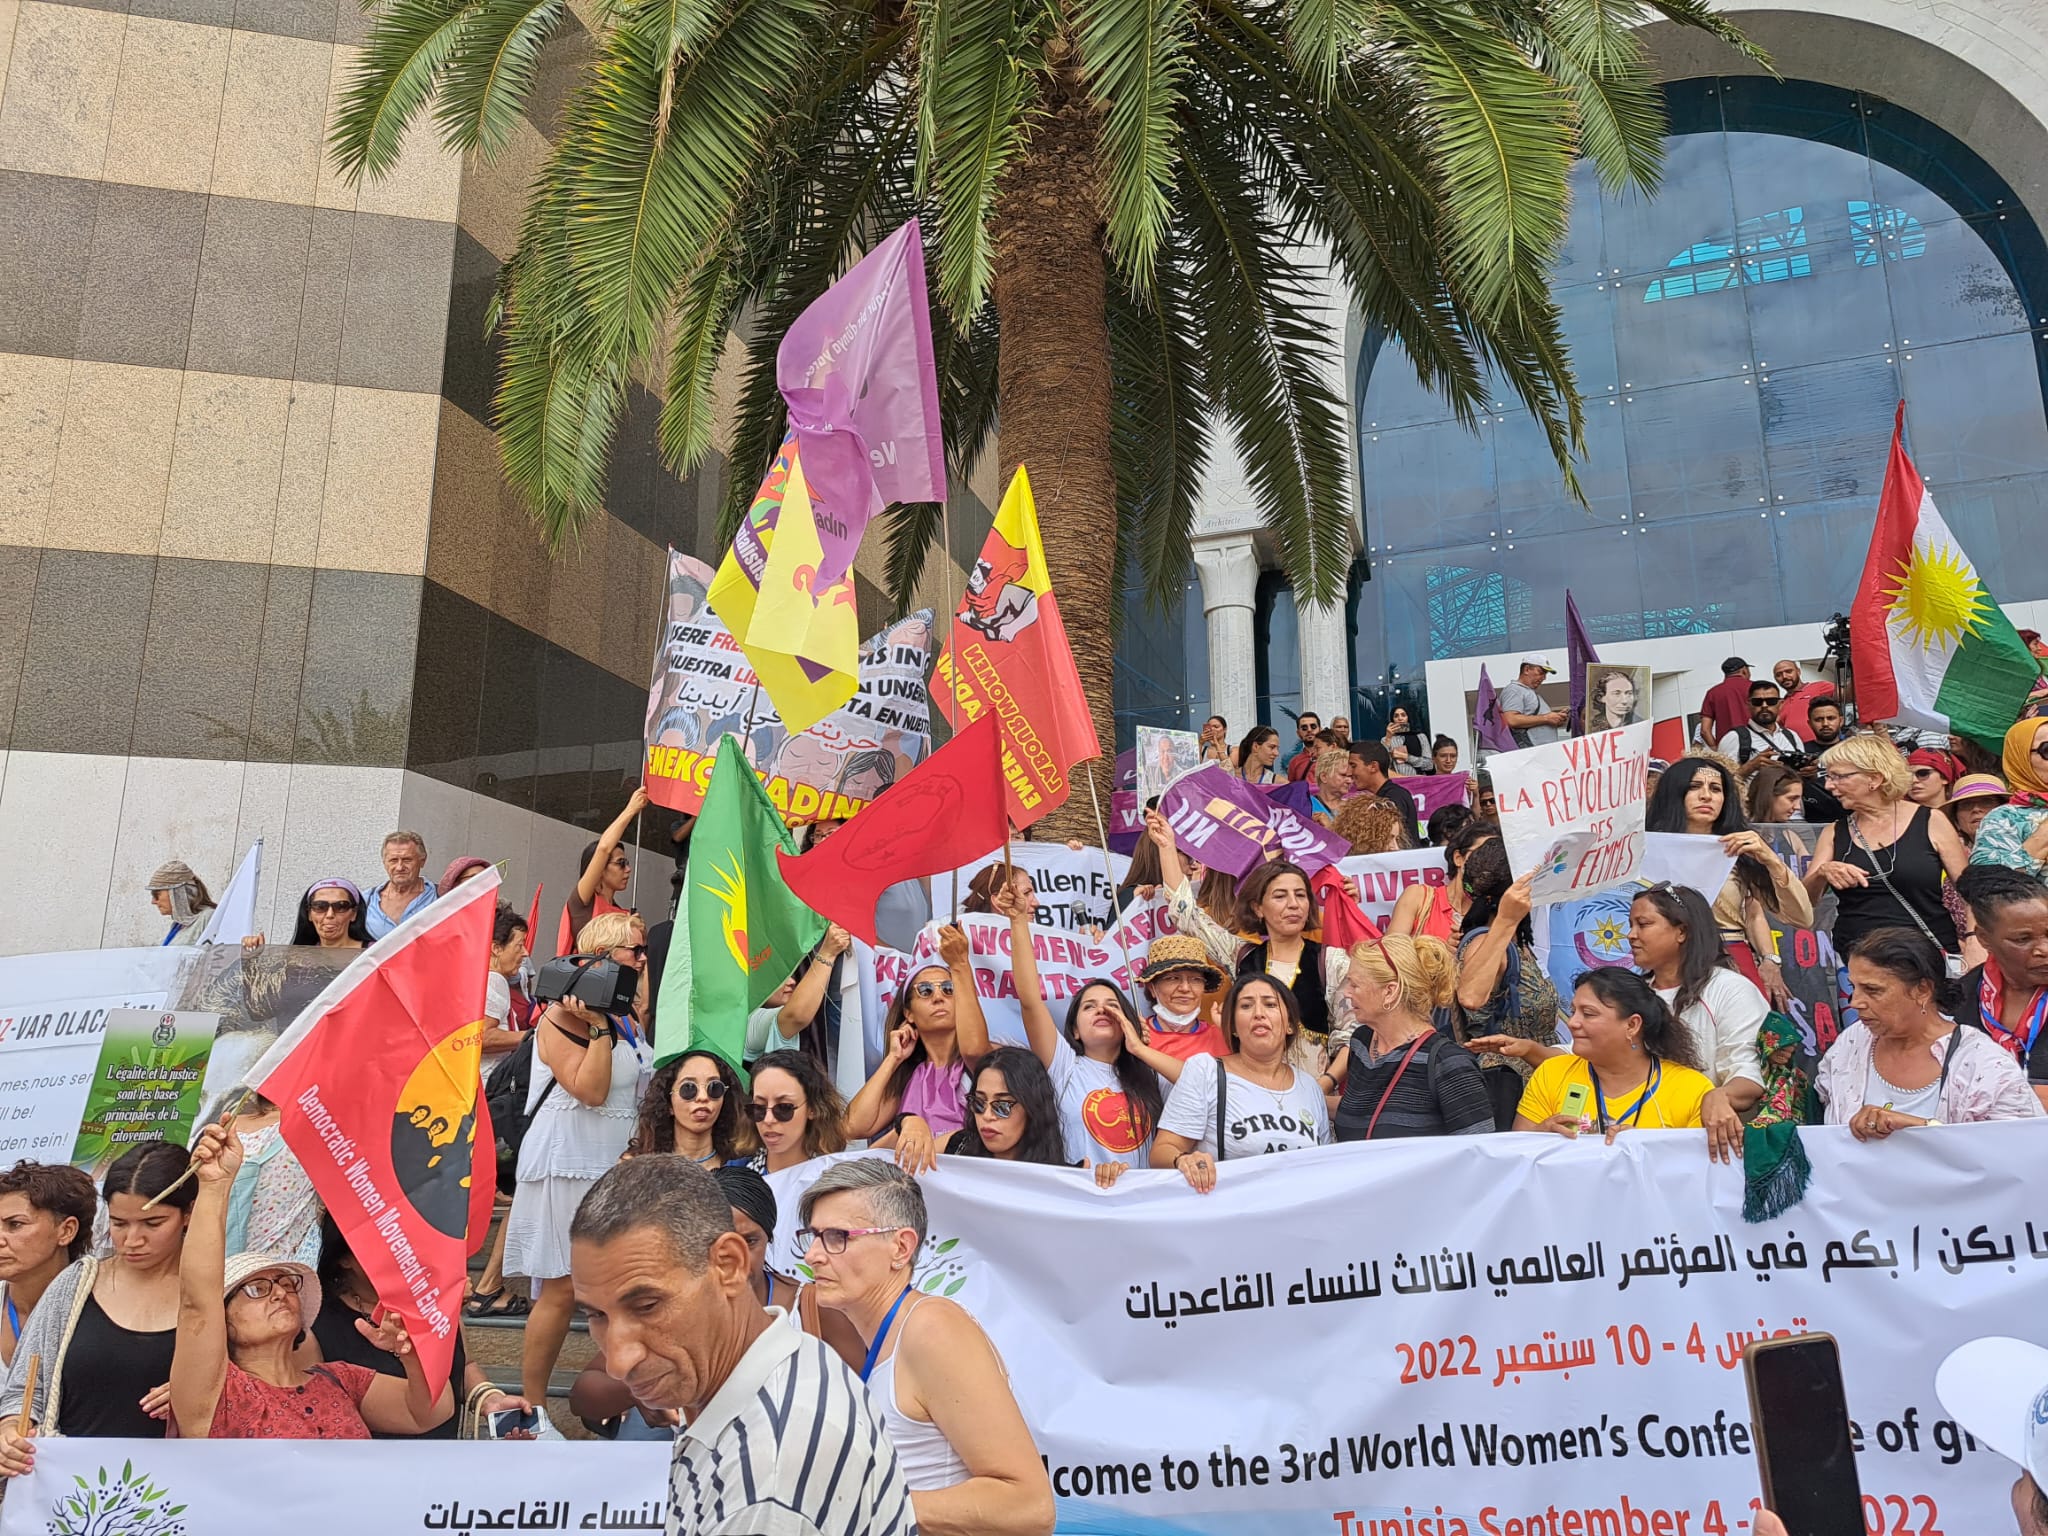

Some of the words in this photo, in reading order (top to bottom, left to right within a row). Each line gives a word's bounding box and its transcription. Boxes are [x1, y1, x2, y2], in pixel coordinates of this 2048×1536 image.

[812, 503, 848, 541] adın
[671, 625, 711, 645] SERE
[710, 632, 744, 652] FRE
[895, 648, 922, 667] IN
[875, 707, 903, 727] EN
[648, 746, 717, 797] EMEKÇ
[753, 770, 873, 821] ADIN
[1498, 788, 1534, 812] LA
[1571, 832, 1638, 889] FEMMES
[0, 1013, 52, 1041] Z-VAR
[116, 1088, 137, 1100] sont
[139, 1085, 152, 1100] les
[154, 1086, 179, 1100] bases
[149, 1068, 158, 1080] et
[159, 1066, 168, 1080] la
[168, 1067, 198, 1081] justice
[11, 1105, 35, 1120] be!
[104, 1106, 156, 1123] principales
[157, 1106, 169, 1120] de
[170, 1106, 179, 1120] la
[297, 1084, 357, 1167] Democratic
[0, 1136, 27, 1151] den
[31, 1132, 68, 1149] sein!
[111, 1128, 164, 1143] citoyenneté
[343, 1157, 385, 1217] Women
[375, 1206, 424, 1284] Movement
[1617, 1232, 1737, 1290] المؤتمر
[1746, 1230, 1808, 1282] في
[1822, 1229, 1899, 1283] بكم
[1938, 1225, 2016, 1275] بكن
[410, 1271, 429, 1297] in
[1287, 1260, 1382, 1306] للنساء
[1391, 1246, 1476, 1294] الثالث
[1486, 1240, 1606, 1297] العالمي
[415, 1288, 452, 1340] Europe
[1125, 1272, 1275, 1328] القاعديات
[1395, 1334, 1481, 1384] 2022
[1493, 1331, 1596, 1388] سبتمبر
[1605, 1323, 1652, 1366] 10
[1686, 1322, 1706, 1364] 4
[1161, 1454, 1200, 1491] to
[1208, 1444, 1270, 1487] the
[1278, 1437, 1340, 1483] 3rd
[1347, 1422, 1454, 1474] World
[1460, 1414, 1629, 1467] Women's
[1876, 1407, 1919, 1454] of
[424, 1501, 570, 1536] القاعديات
[579, 1501, 667, 1530] لنساء
[1861, 1494, 1945, 1536] 022
